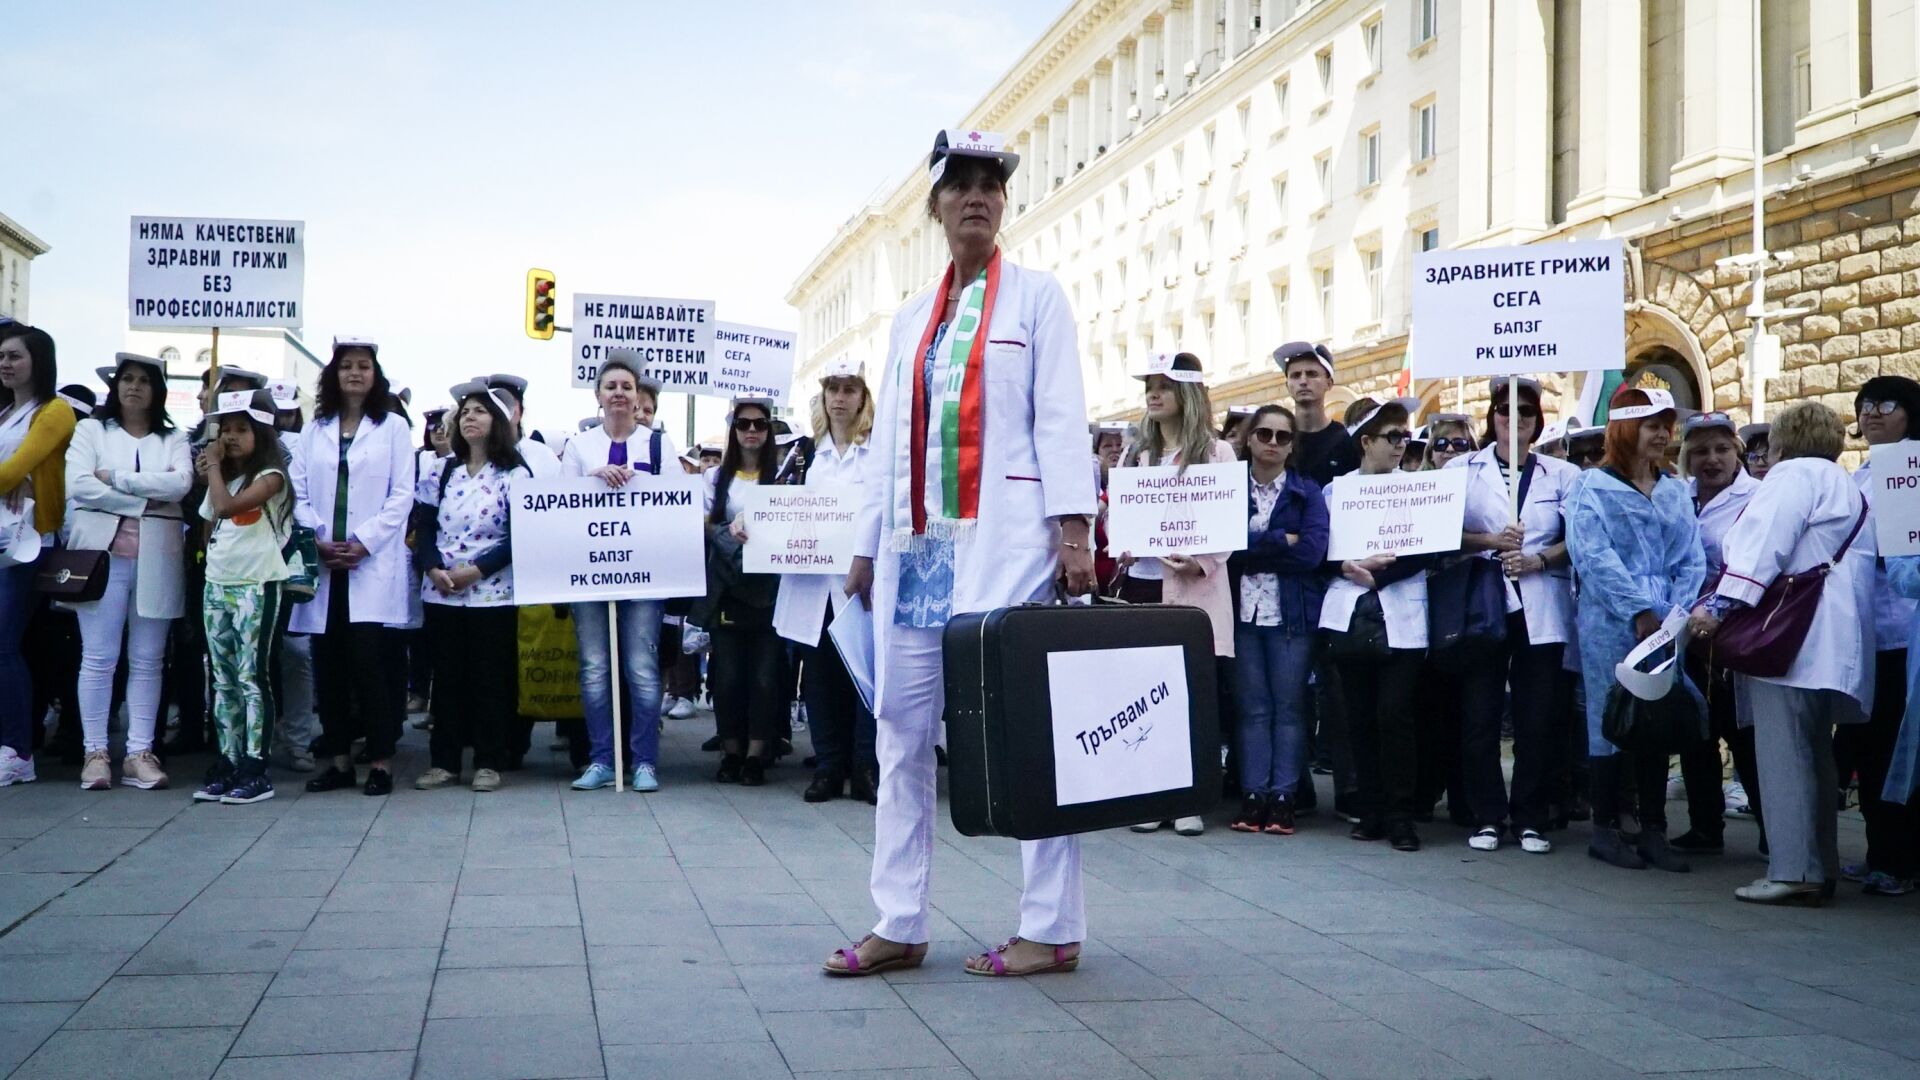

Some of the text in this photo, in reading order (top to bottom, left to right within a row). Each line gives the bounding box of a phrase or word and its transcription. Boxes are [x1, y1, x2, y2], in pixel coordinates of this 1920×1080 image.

[139, 222, 296, 244] НЯМА КАЧЕСТВЕНИ
[147, 248, 287, 269] ЗДРАВНИ ГРИЖИ
[1426, 255, 1611, 284] ЗДРАВНИТЕ ГРИЖИ
[203, 274, 232, 293] БЕЗ
[1493, 290, 1541, 308] СЕГА
[135, 297, 296, 319] ПРОФЕСИОНАЛИСТИ
[584, 302, 705, 323] НЕ ЛИШАВАЙТЕ
[593, 324, 695, 344] ПАЦИЕНТИТЕ
[1493, 319, 1542, 335] БАПЗГ
[716, 330, 790, 350] ВНИТЕ ГРИЖИ
[581, 344, 601, 360] ОТ
[724, 349, 751, 363] СЕГА
[1476, 343, 1557, 360] РК ШУМЕН
[654, 369, 708, 386] ГРИЖИ
[721, 367, 751, 379] БАПЗГ
[714, 380, 736, 391] ИКО
[1137, 475, 1216, 488] НАЦИОНАЛЕН
[1359, 482, 1436, 496] НАЦИОНАЛЕН
[523, 490, 692, 512] ЗДРАВНИТЕ ГРИЖИ
[769, 496, 838, 508] НАЦИОНАЛЕН
[1120, 489, 1237, 504] ПРОТЕСТЕН МИТИНГ
[1341, 493, 1455, 511] ПРОТЕСТЕН МИТИНГ
[753, 511, 855, 522] ПРОТЕСТЕН МИТИНГ
[587, 521, 632, 538] СЕГА
[1160, 520, 1197, 532] БАПЗГ
[1378, 523, 1415, 536] БАПЗГ
[786, 538, 819, 550] БАПЗГ
[1149, 535, 1208, 548] РК ШУМЕН
[1366, 537, 1423, 551] РК ШУМЕН
[589, 549, 633, 564] БАПЗГ
[770, 553, 834, 565] РК МОНТАНА
[570, 571, 651, 586] РК СМОЛЯН
[1647, 629, 1671, 651] БАПЗГ
[1075, 681, 1170, 756] Тръгвам си
